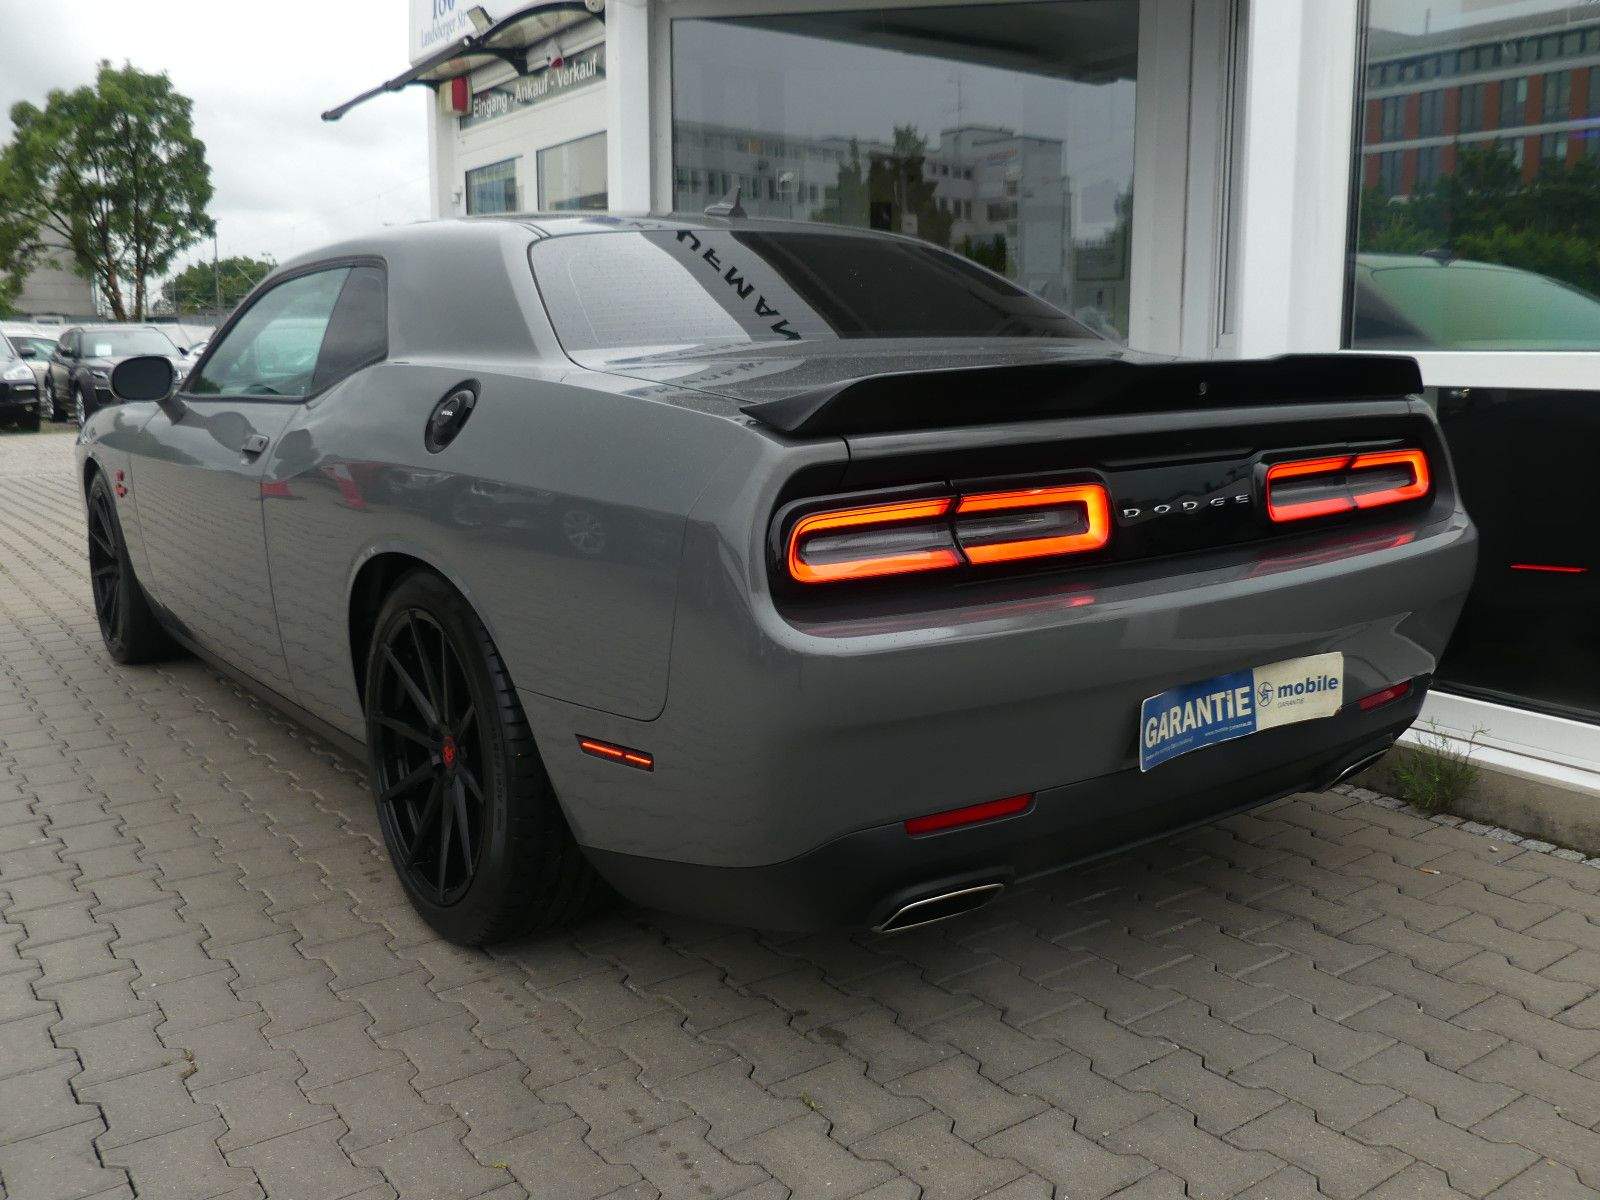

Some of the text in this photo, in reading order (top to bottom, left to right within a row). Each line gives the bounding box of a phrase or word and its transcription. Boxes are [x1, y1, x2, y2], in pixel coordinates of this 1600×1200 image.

[473, 52, 598, 119] Eingang Ankauf Verkauf
[1123, 494, 1250, 518] DODGE
[1277, 675, 1339, 698] mobile
